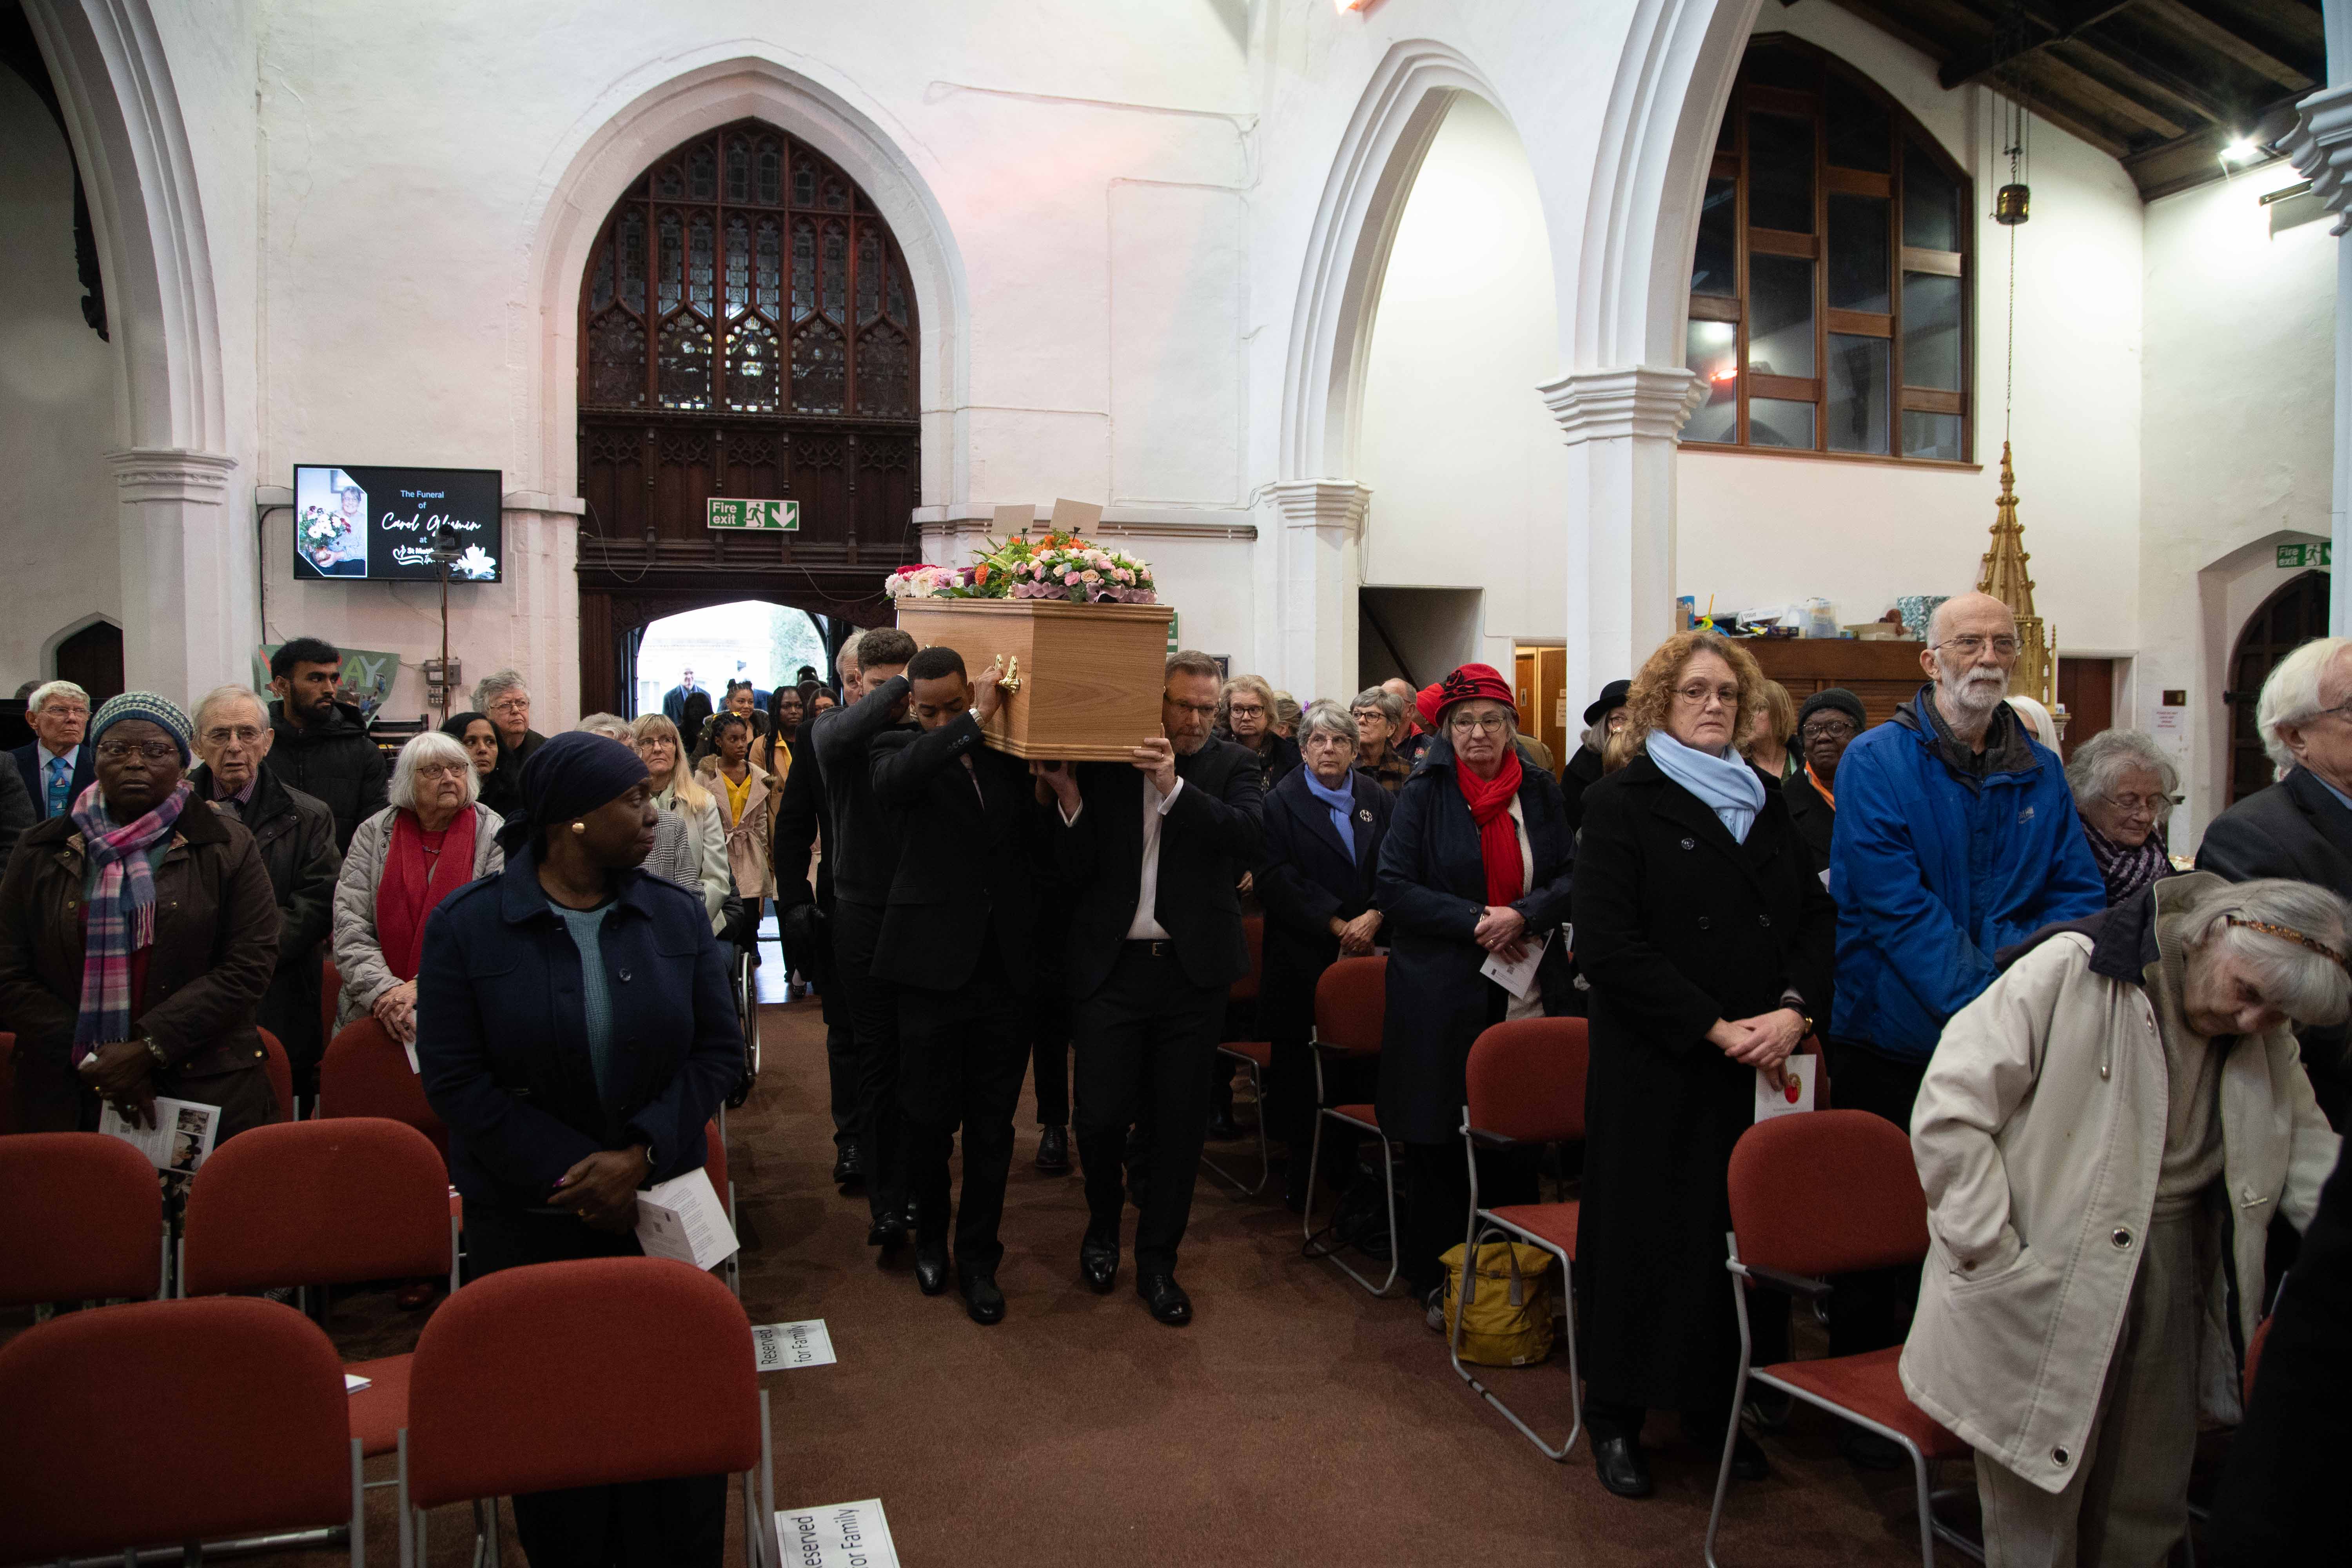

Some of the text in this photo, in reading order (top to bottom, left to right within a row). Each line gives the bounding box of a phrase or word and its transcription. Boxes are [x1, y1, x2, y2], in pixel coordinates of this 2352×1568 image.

[713, 502, 737, 513] Fire
[382, 512, 420, 531] Carol
[713, 514, 736, 524] exit
[2278, 547, 2299, 556] Fire
[2278, 556, 2298, 566] exit
[754, 1330, 778, 1365] Reserved
[787, 1325, 812, 1362] for Family
[791, 1516, 822, 1568] eserved
[833, 1510, 868, 1568] or Family
